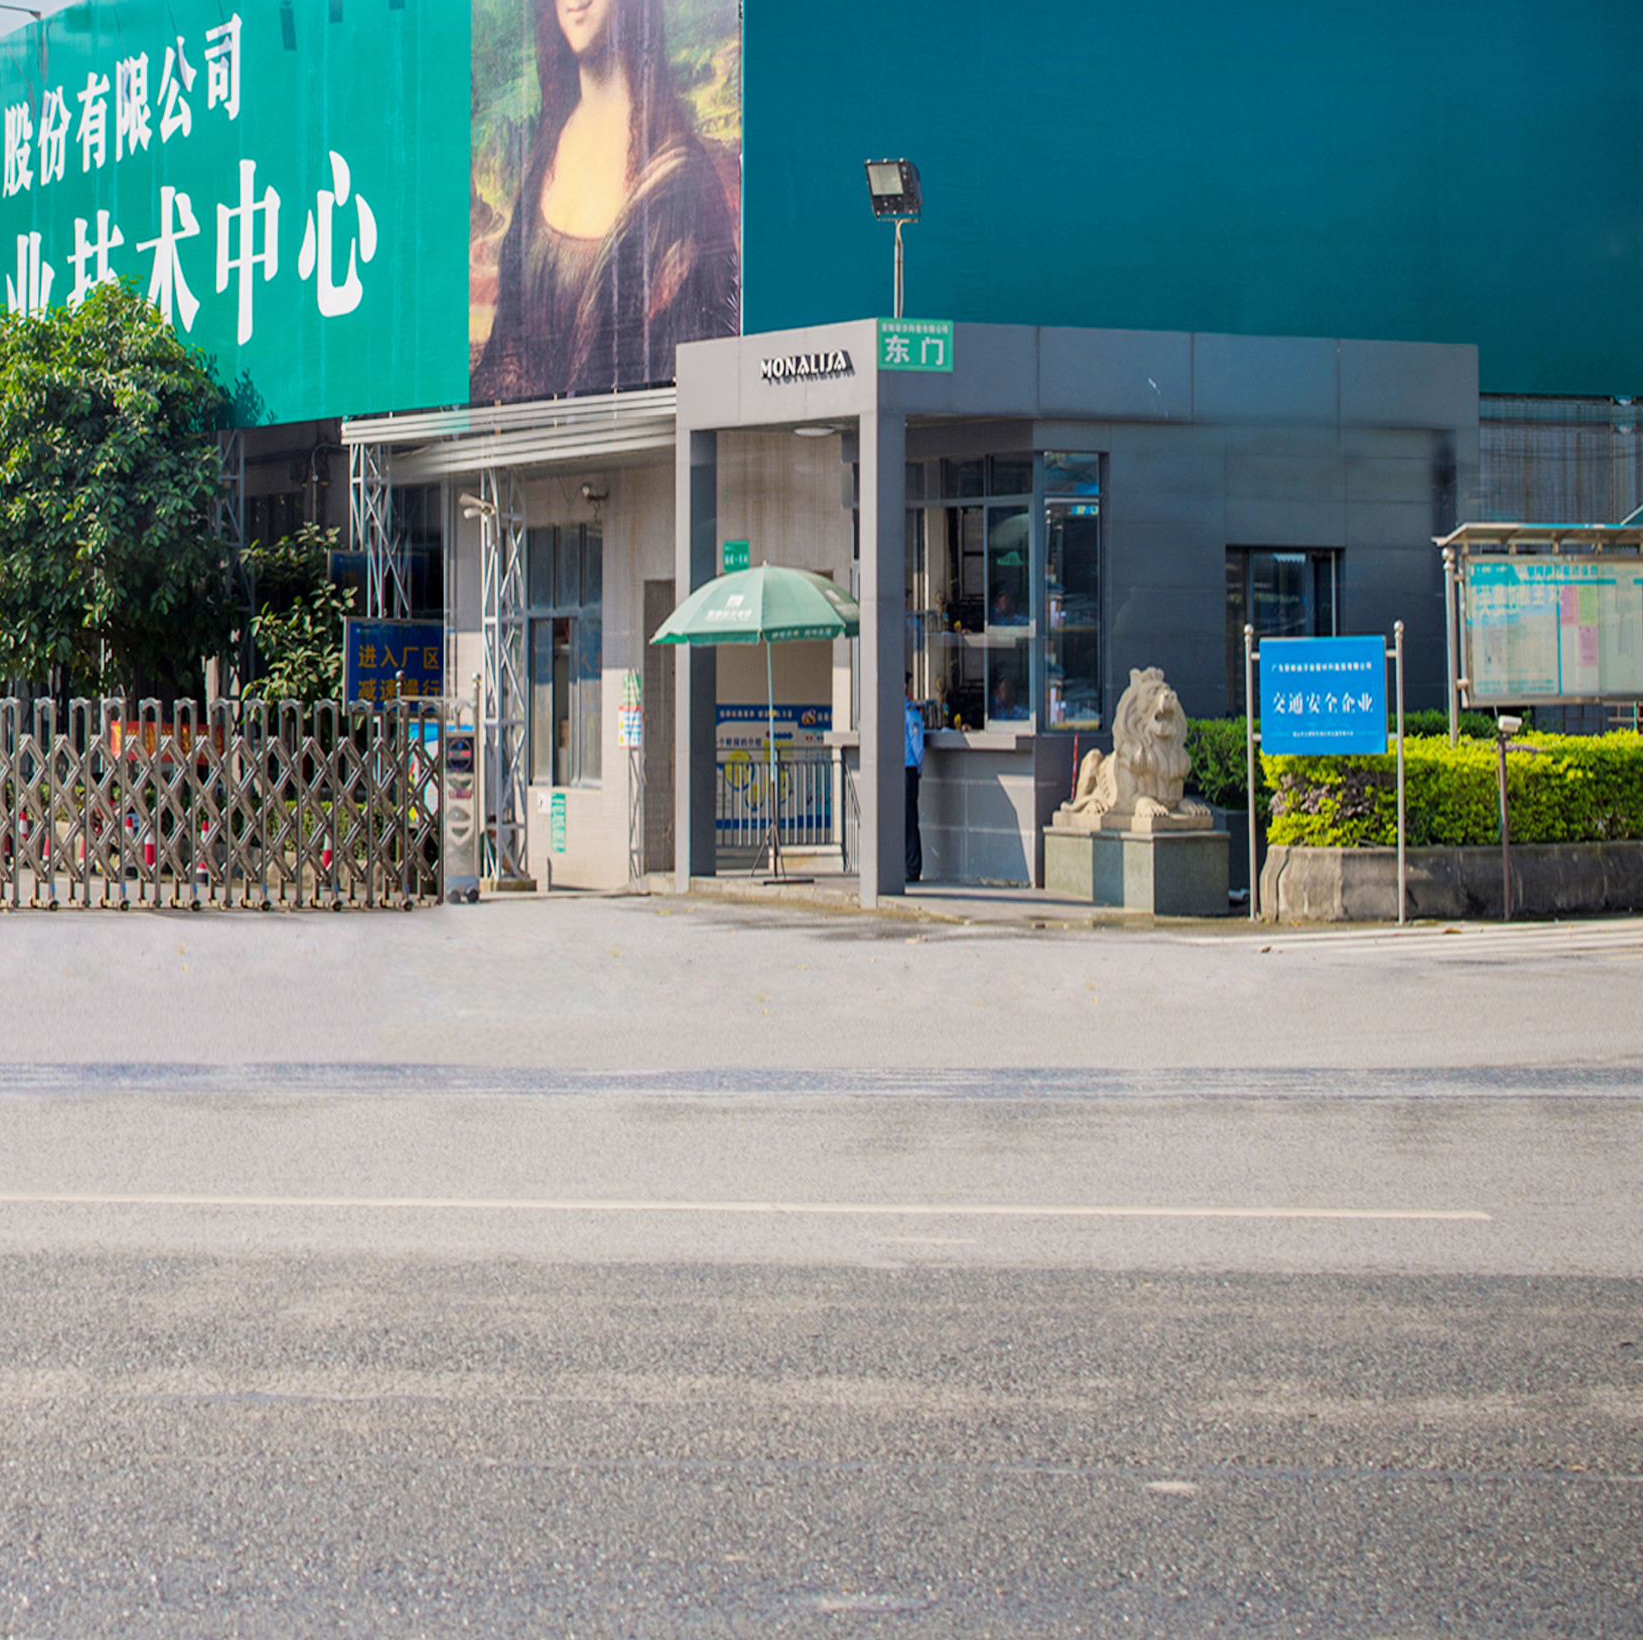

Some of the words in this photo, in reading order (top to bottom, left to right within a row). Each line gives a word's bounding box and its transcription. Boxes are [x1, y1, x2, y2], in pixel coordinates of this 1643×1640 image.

[884, 334, 944, 366] 东门
[760, 349, 848, 379] MONALISA
[358, 645, 440, 669] 进入厂区
[1273, 691, 1373, 715] 交通安全企业
